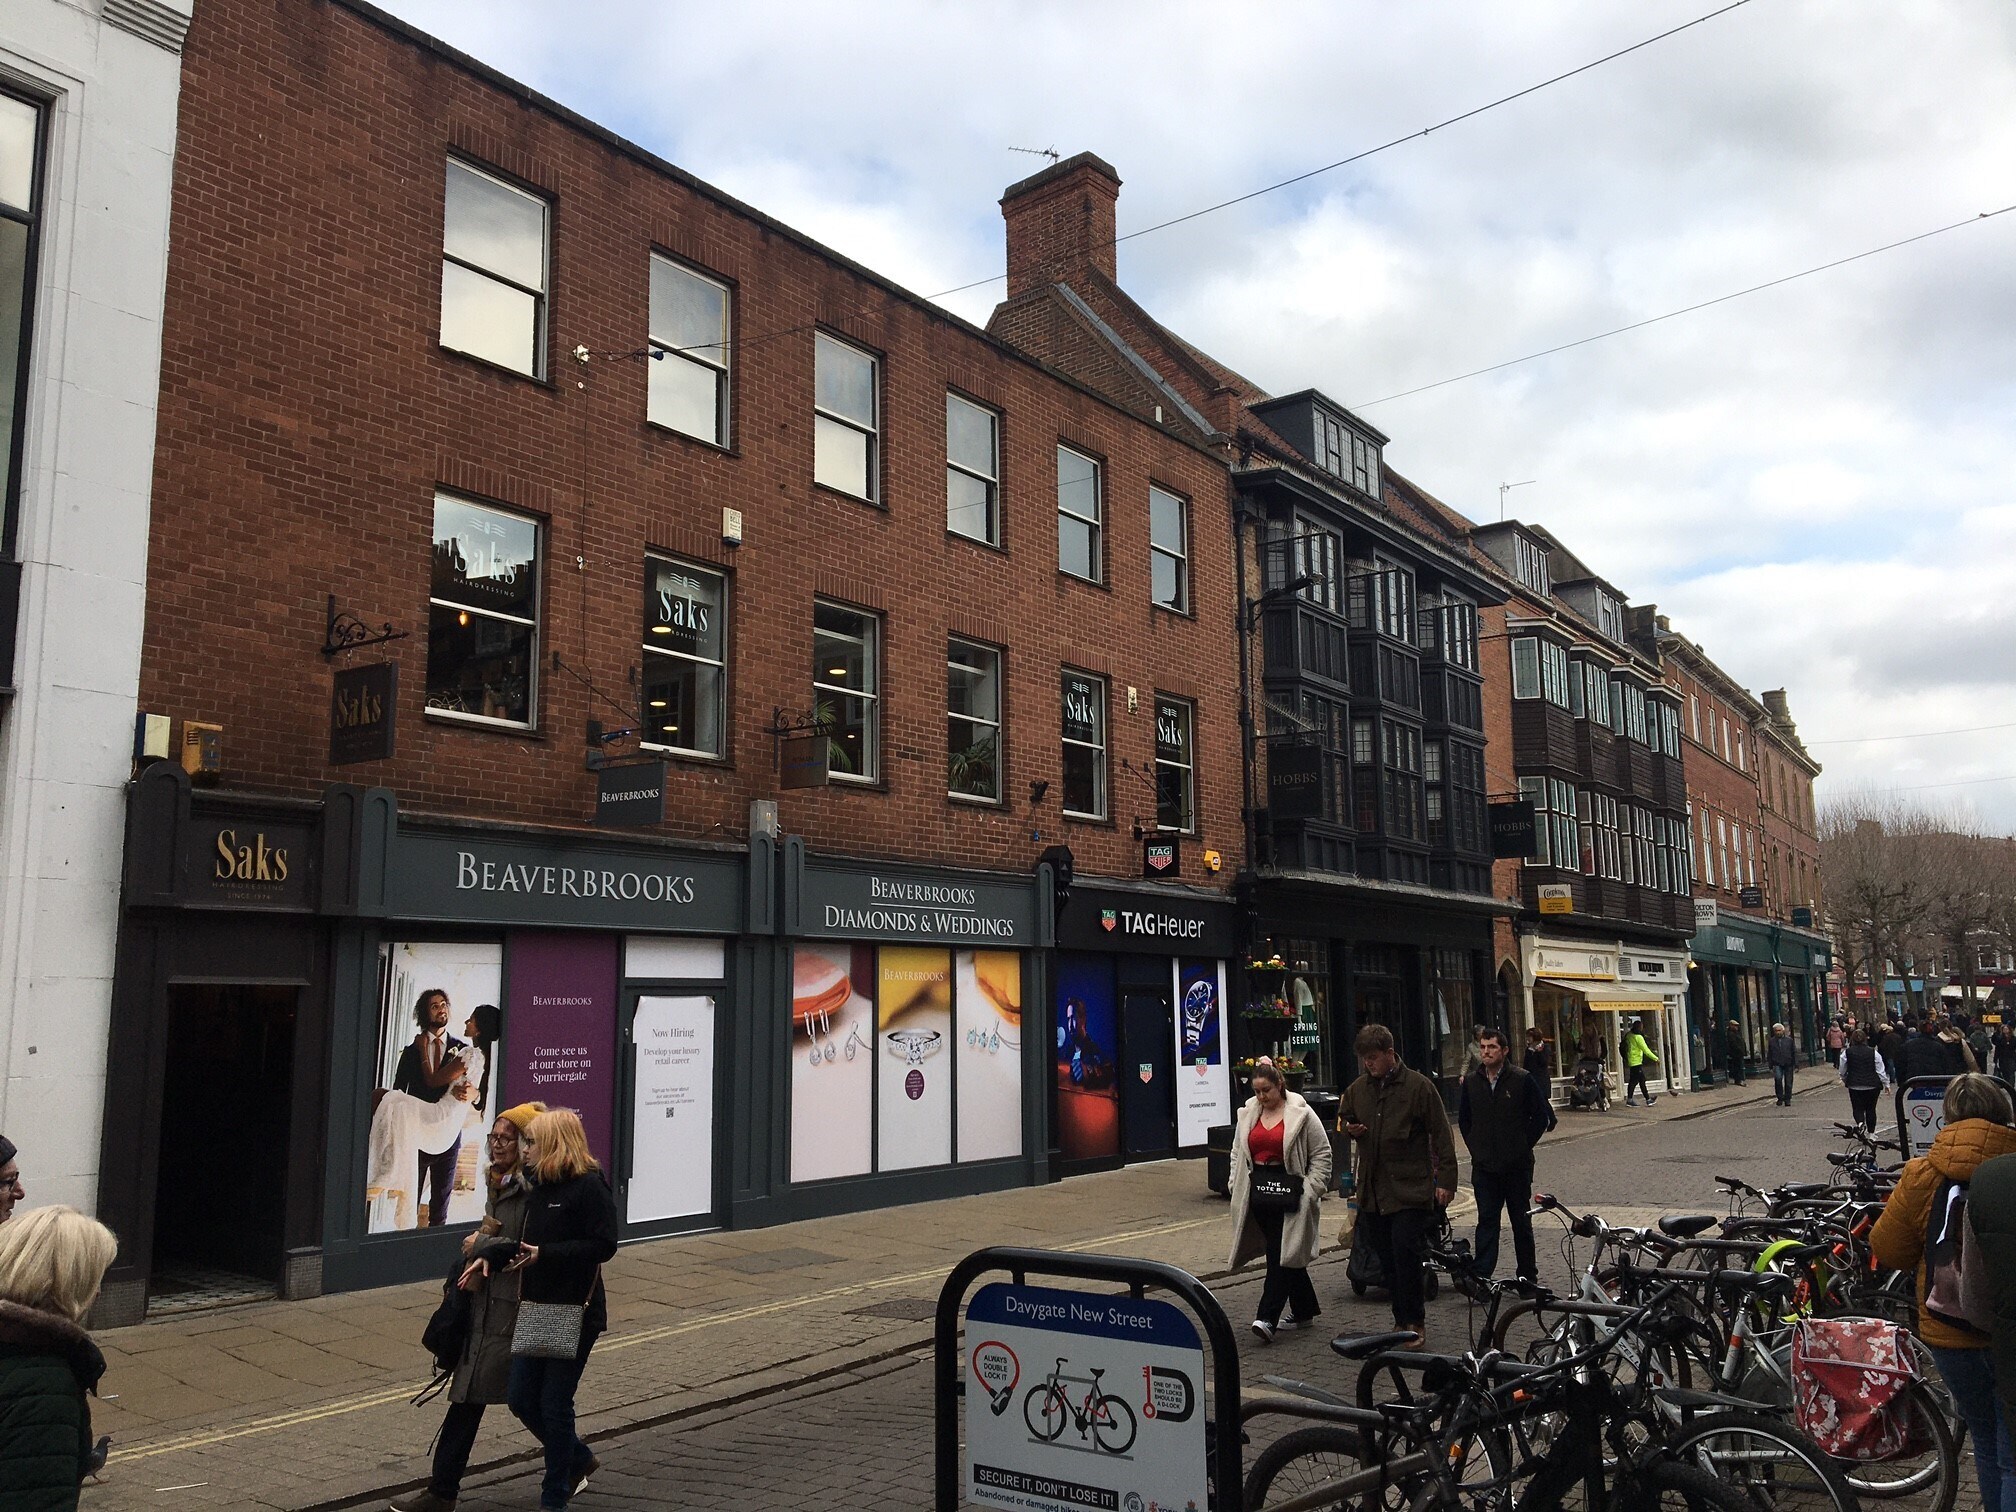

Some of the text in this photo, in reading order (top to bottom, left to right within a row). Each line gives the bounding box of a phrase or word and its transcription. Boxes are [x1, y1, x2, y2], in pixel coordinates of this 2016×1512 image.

[454, 532, 515, 584] Saks
[453, 577, 515, 597] HAIRDRESSING
[659, 586, 708, 632] Saks
[336, 685, 381, 729] Saks
[1066, 692, 1095, 725] Saks
[1158, 716, 1183, 746] Saks
[1273, 771, 1317, 786] HOBBS
[601, 789, 660, 803] BEAVERBROOKS
[216, 829, 288, 882] Saks
[1150, 847, 1170, 856] TAG
[456, 851, 694, 904] BEAVERBROOKS
[870, 876, 976, 905] BEAVERBROOKS
[824, 904, 1014, 937] DIAMONDS & WEDDINGS
[884, 968, 944, 983] BEAVERBROOKS
[533, 995, 592, 1006] BEAVERBROOKS
[652, 1027, 695, 1039] Now Hiring
[1293, 1022, 1318, 1032] SPRING
[1292, 1035, 1320, 1045] SEEKING
[534, 1046, 588, 1057] Come see us
[643, 1046, 701, 1057] Develop your luxury
[528, 1059, 592, 1070] at our store on
[654, 1056, 690, 1065] retail career
[1140, 1064, 1152, 1072] TAG
[532, 1071, 588, 1085] Spurriergate
[1006, 1296, 1153, 1330] Davygate New Street
[983, 1354, 1008, 1364] ALWAYS
[983, 1362, 1008, 1373] DOUBLE
[984, 1371, 1007, 1381] LOCK IT
[1154, 1394, 1175, 1402] SHOULD
[979, 1469, 1114, 1507] SECURE IT, DON'T LOSE IT!
[974, 1488, 1015, 1504] Abandoned
[1025, 1499, 1059, 1512] damaged
